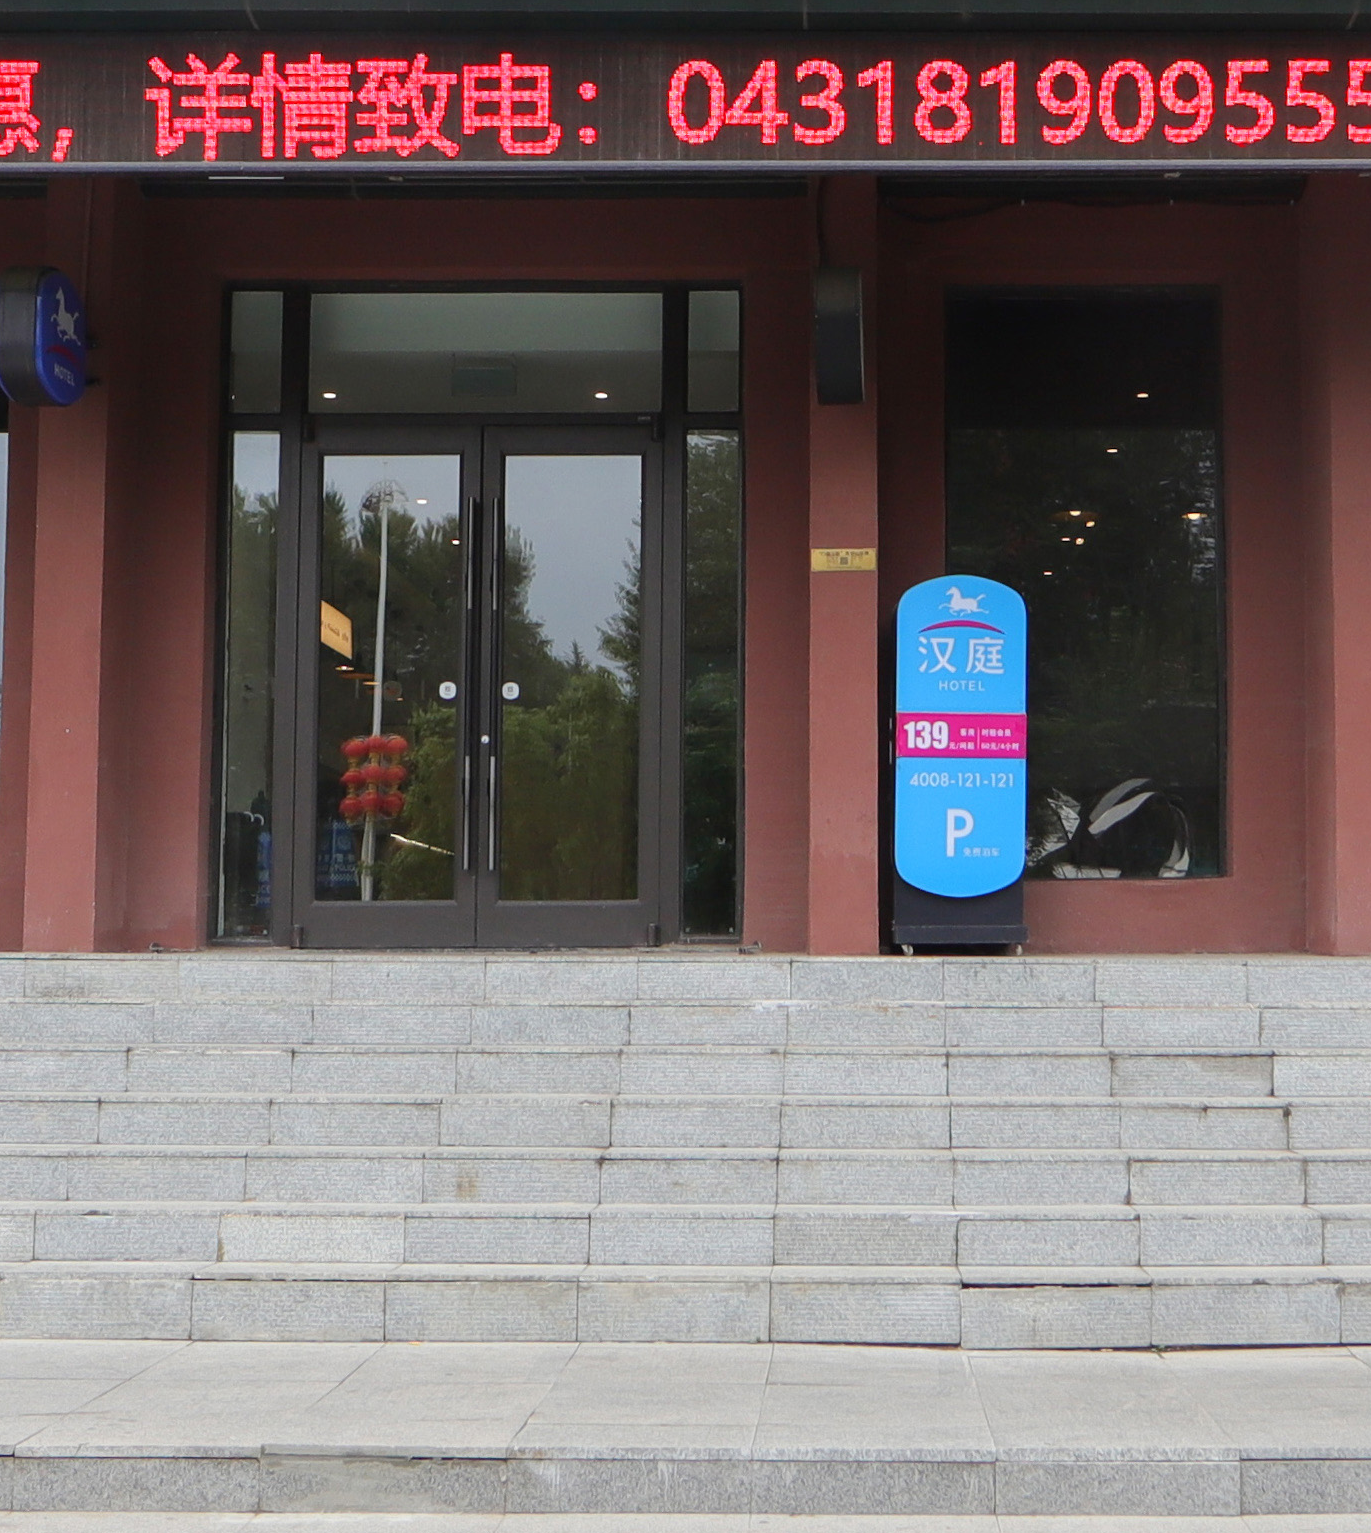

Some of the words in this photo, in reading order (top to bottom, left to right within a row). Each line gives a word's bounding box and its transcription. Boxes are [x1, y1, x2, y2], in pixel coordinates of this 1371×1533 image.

[53, 362, 76, 387] HOTEL
[918, 635, 1005, 675] 汉庭
[938, 680, 986, 692] HOTEL
[903, 720, 950, 750] 139
[909, 771, 1015, 788] 4008-121-121
[945, 808, 975, 858] P
